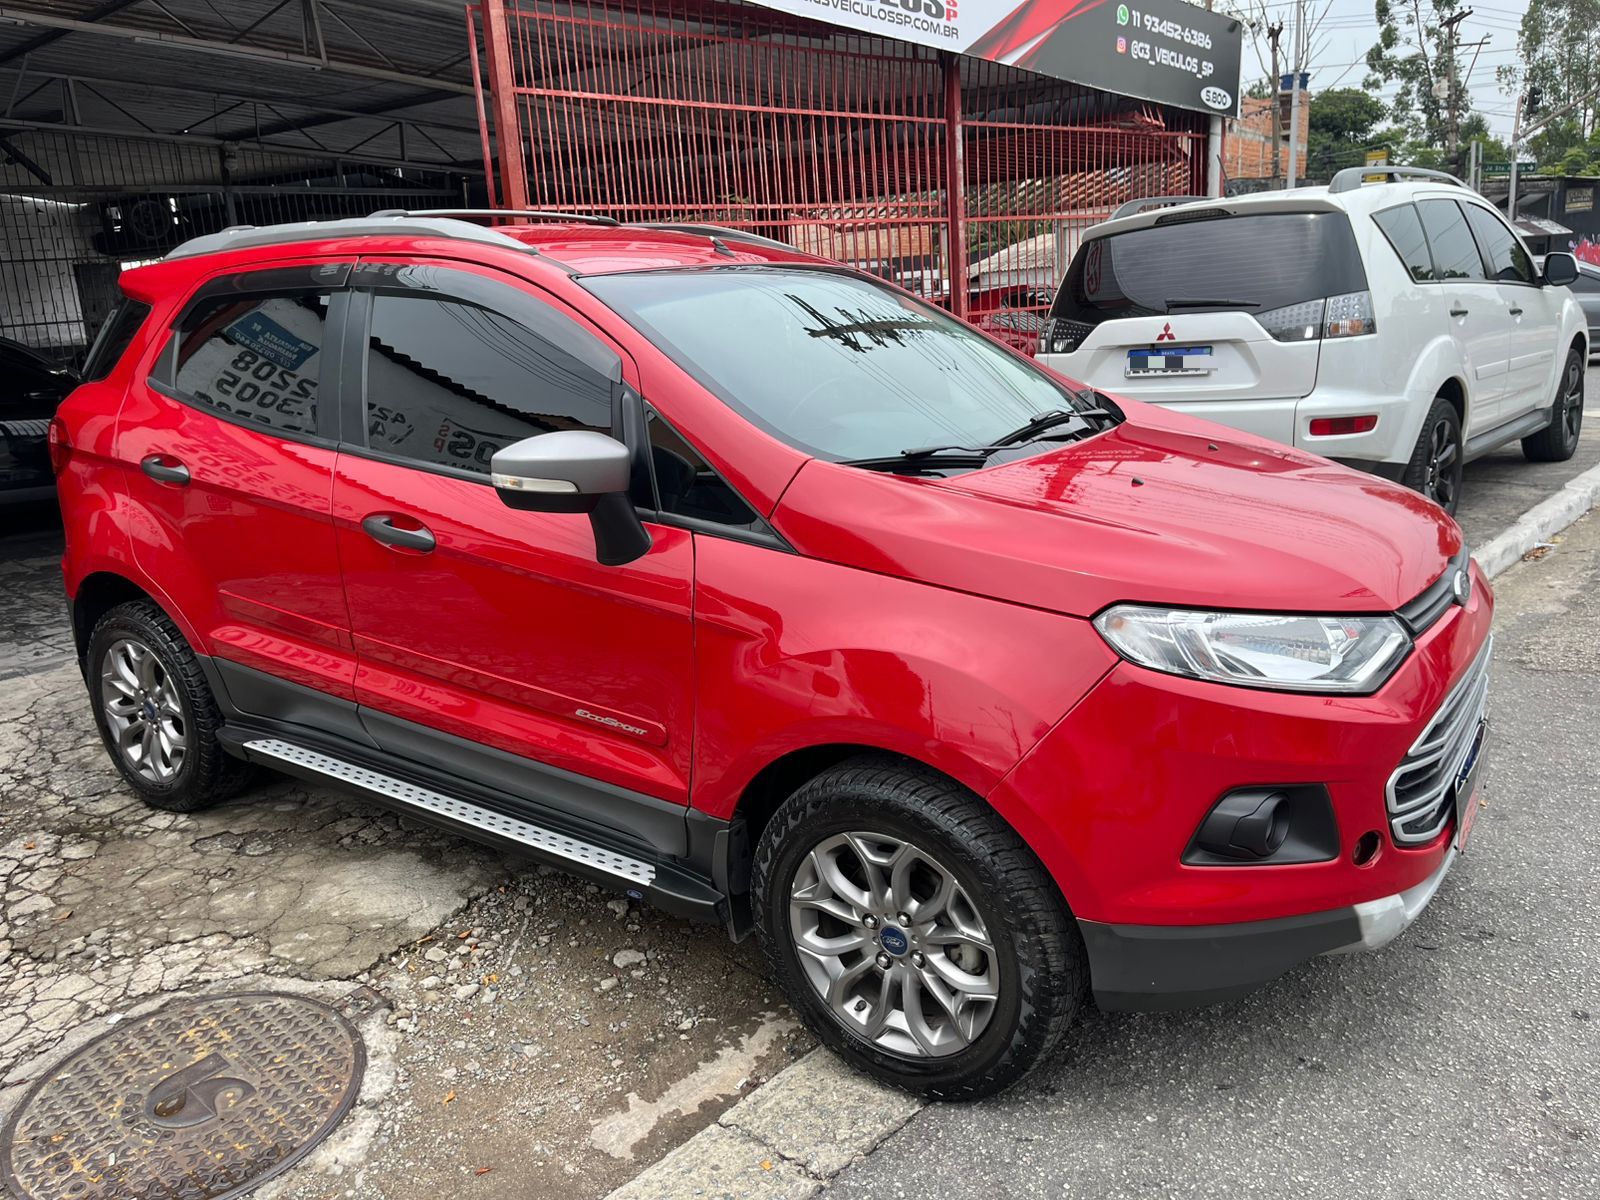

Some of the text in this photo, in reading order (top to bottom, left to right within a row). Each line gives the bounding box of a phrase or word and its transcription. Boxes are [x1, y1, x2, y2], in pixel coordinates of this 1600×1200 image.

[1132, 10, 1212, 50] 11 93452-6386
[1131, 40, 1214, 79] @G3_VEICULOS_SP
